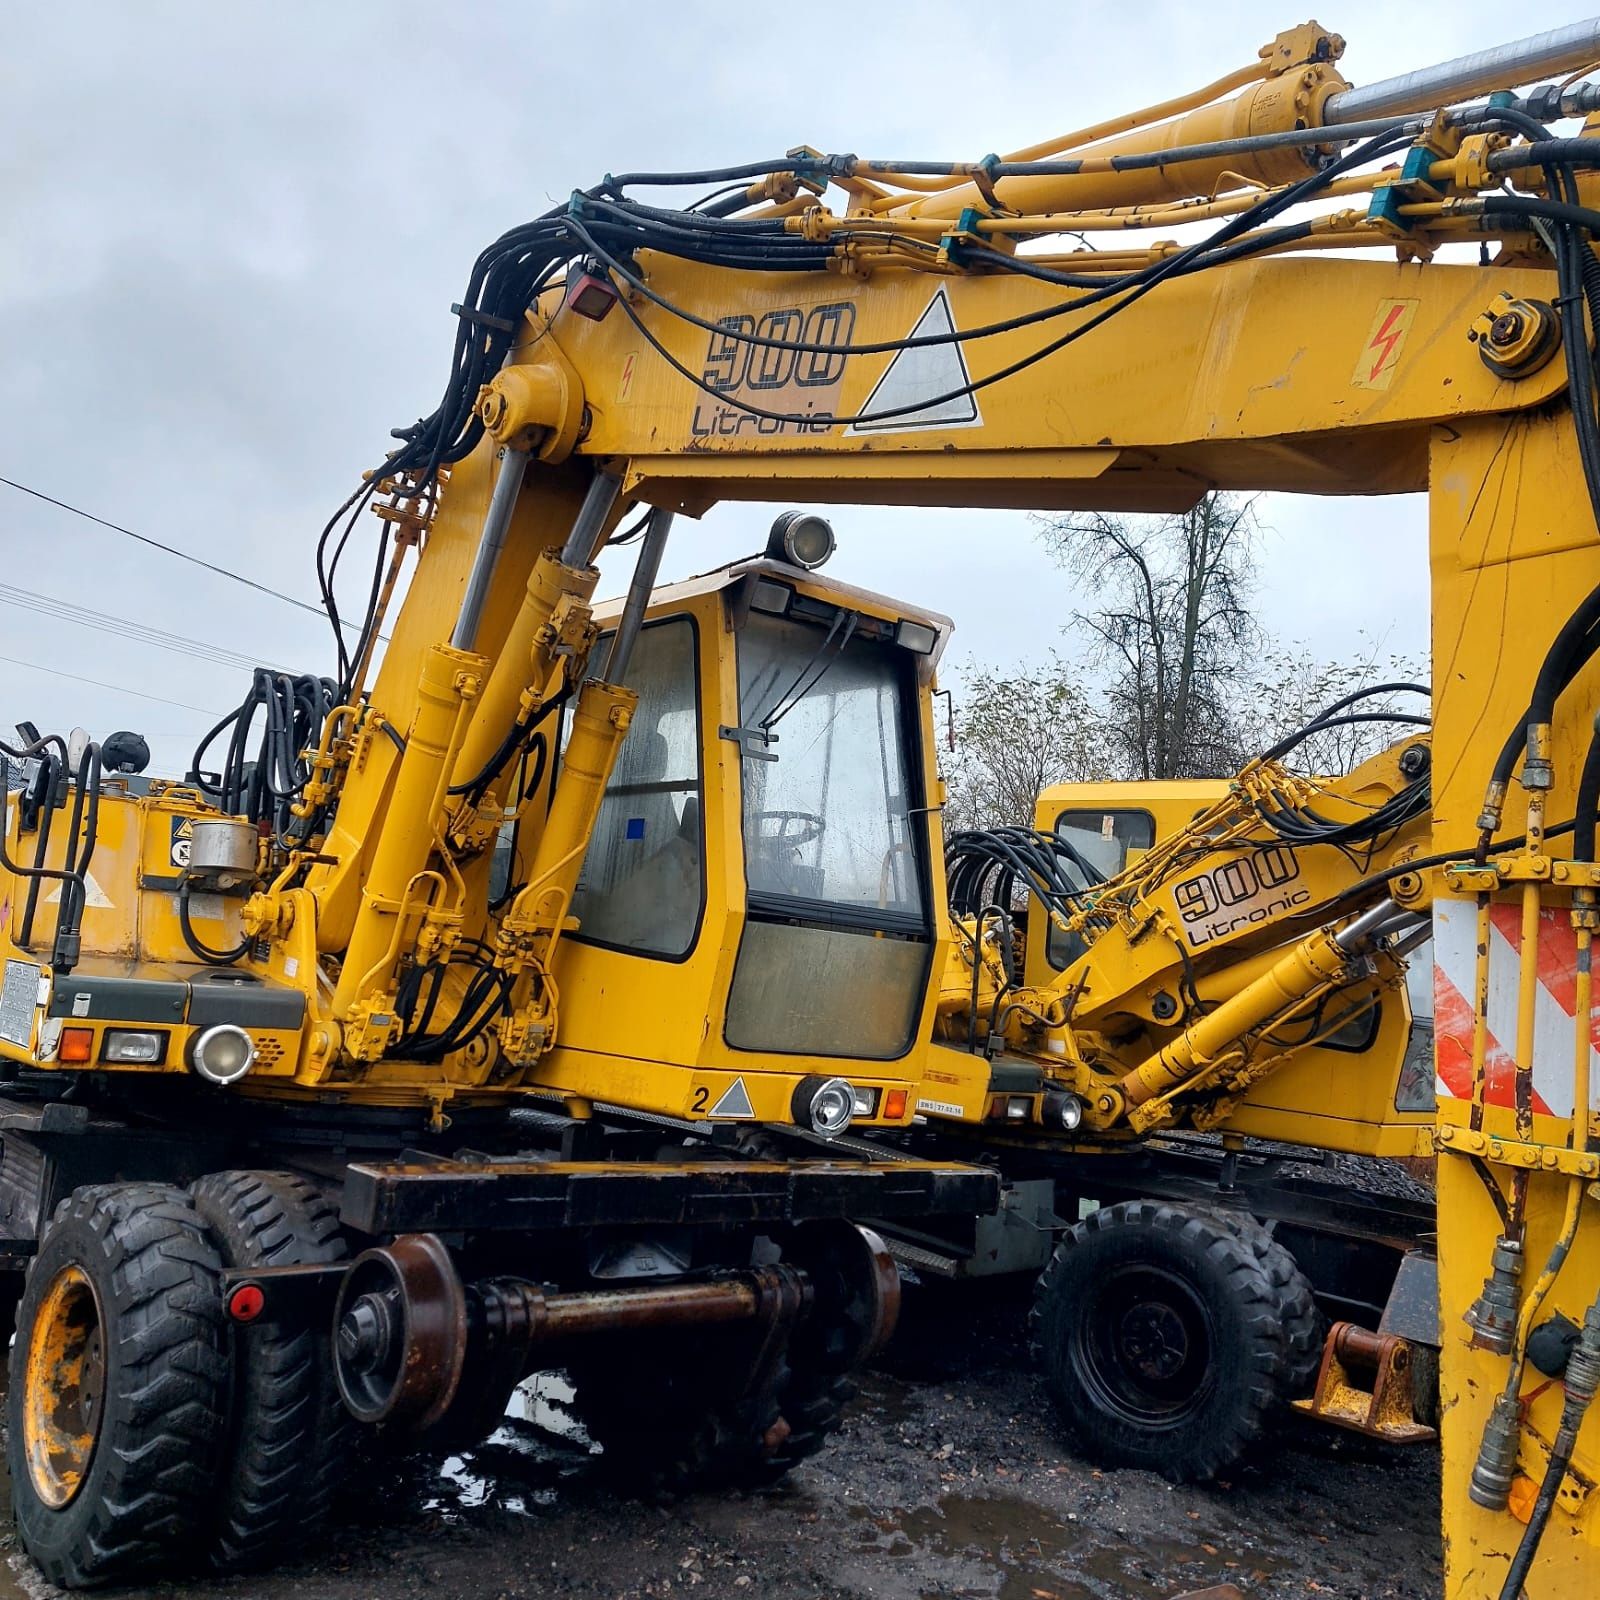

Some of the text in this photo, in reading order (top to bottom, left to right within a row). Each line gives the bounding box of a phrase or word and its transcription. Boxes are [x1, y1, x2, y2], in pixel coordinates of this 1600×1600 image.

[703, 301, 857, 392] 900
[691, 401, 834, 436] Litronic
[1174, 847, 1300, 923] 900
[1187, 889, 1311, 947] Litronic
[691, 1086, 710, 1113] 2
